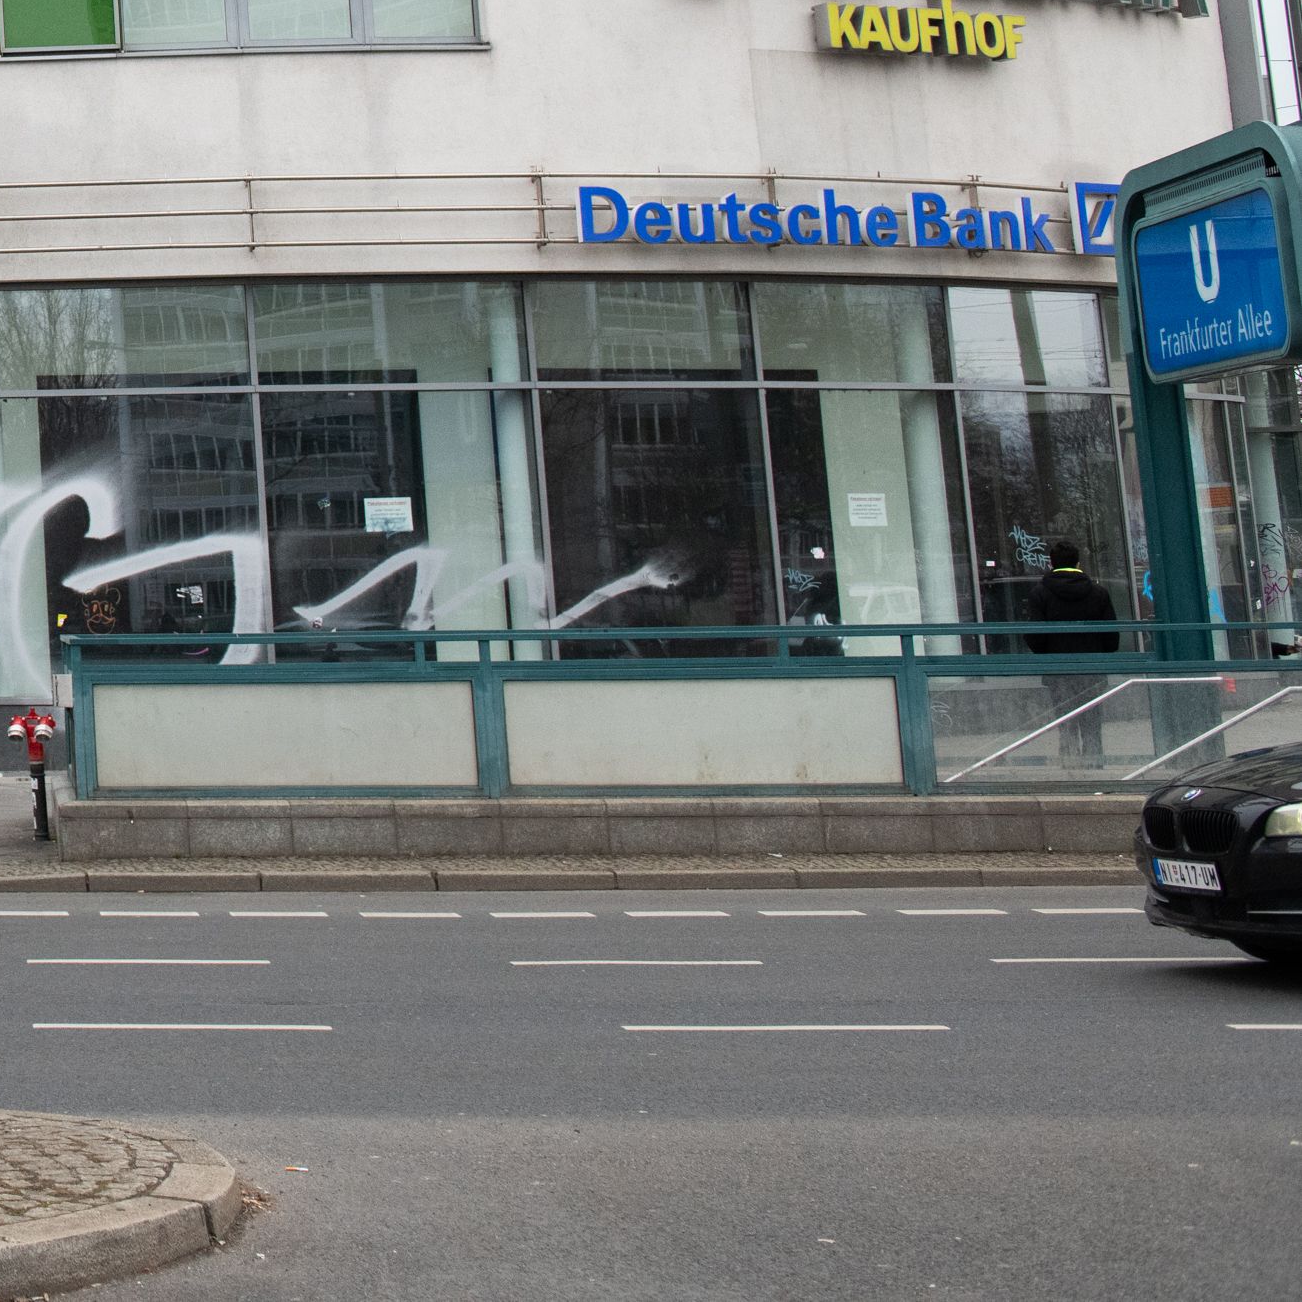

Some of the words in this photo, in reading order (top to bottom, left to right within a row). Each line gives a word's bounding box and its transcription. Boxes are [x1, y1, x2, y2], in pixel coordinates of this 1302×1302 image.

[578, 185, 898, 247] Deutsche
[908, 191, 1056, 253] Bank
[1189, 219, 1220, 304] U
[1159, 317, 1233, 360] Frankfurter
[1238, 303, 1273, 343] Allee
[1159, 862, 1173, 883] NI
